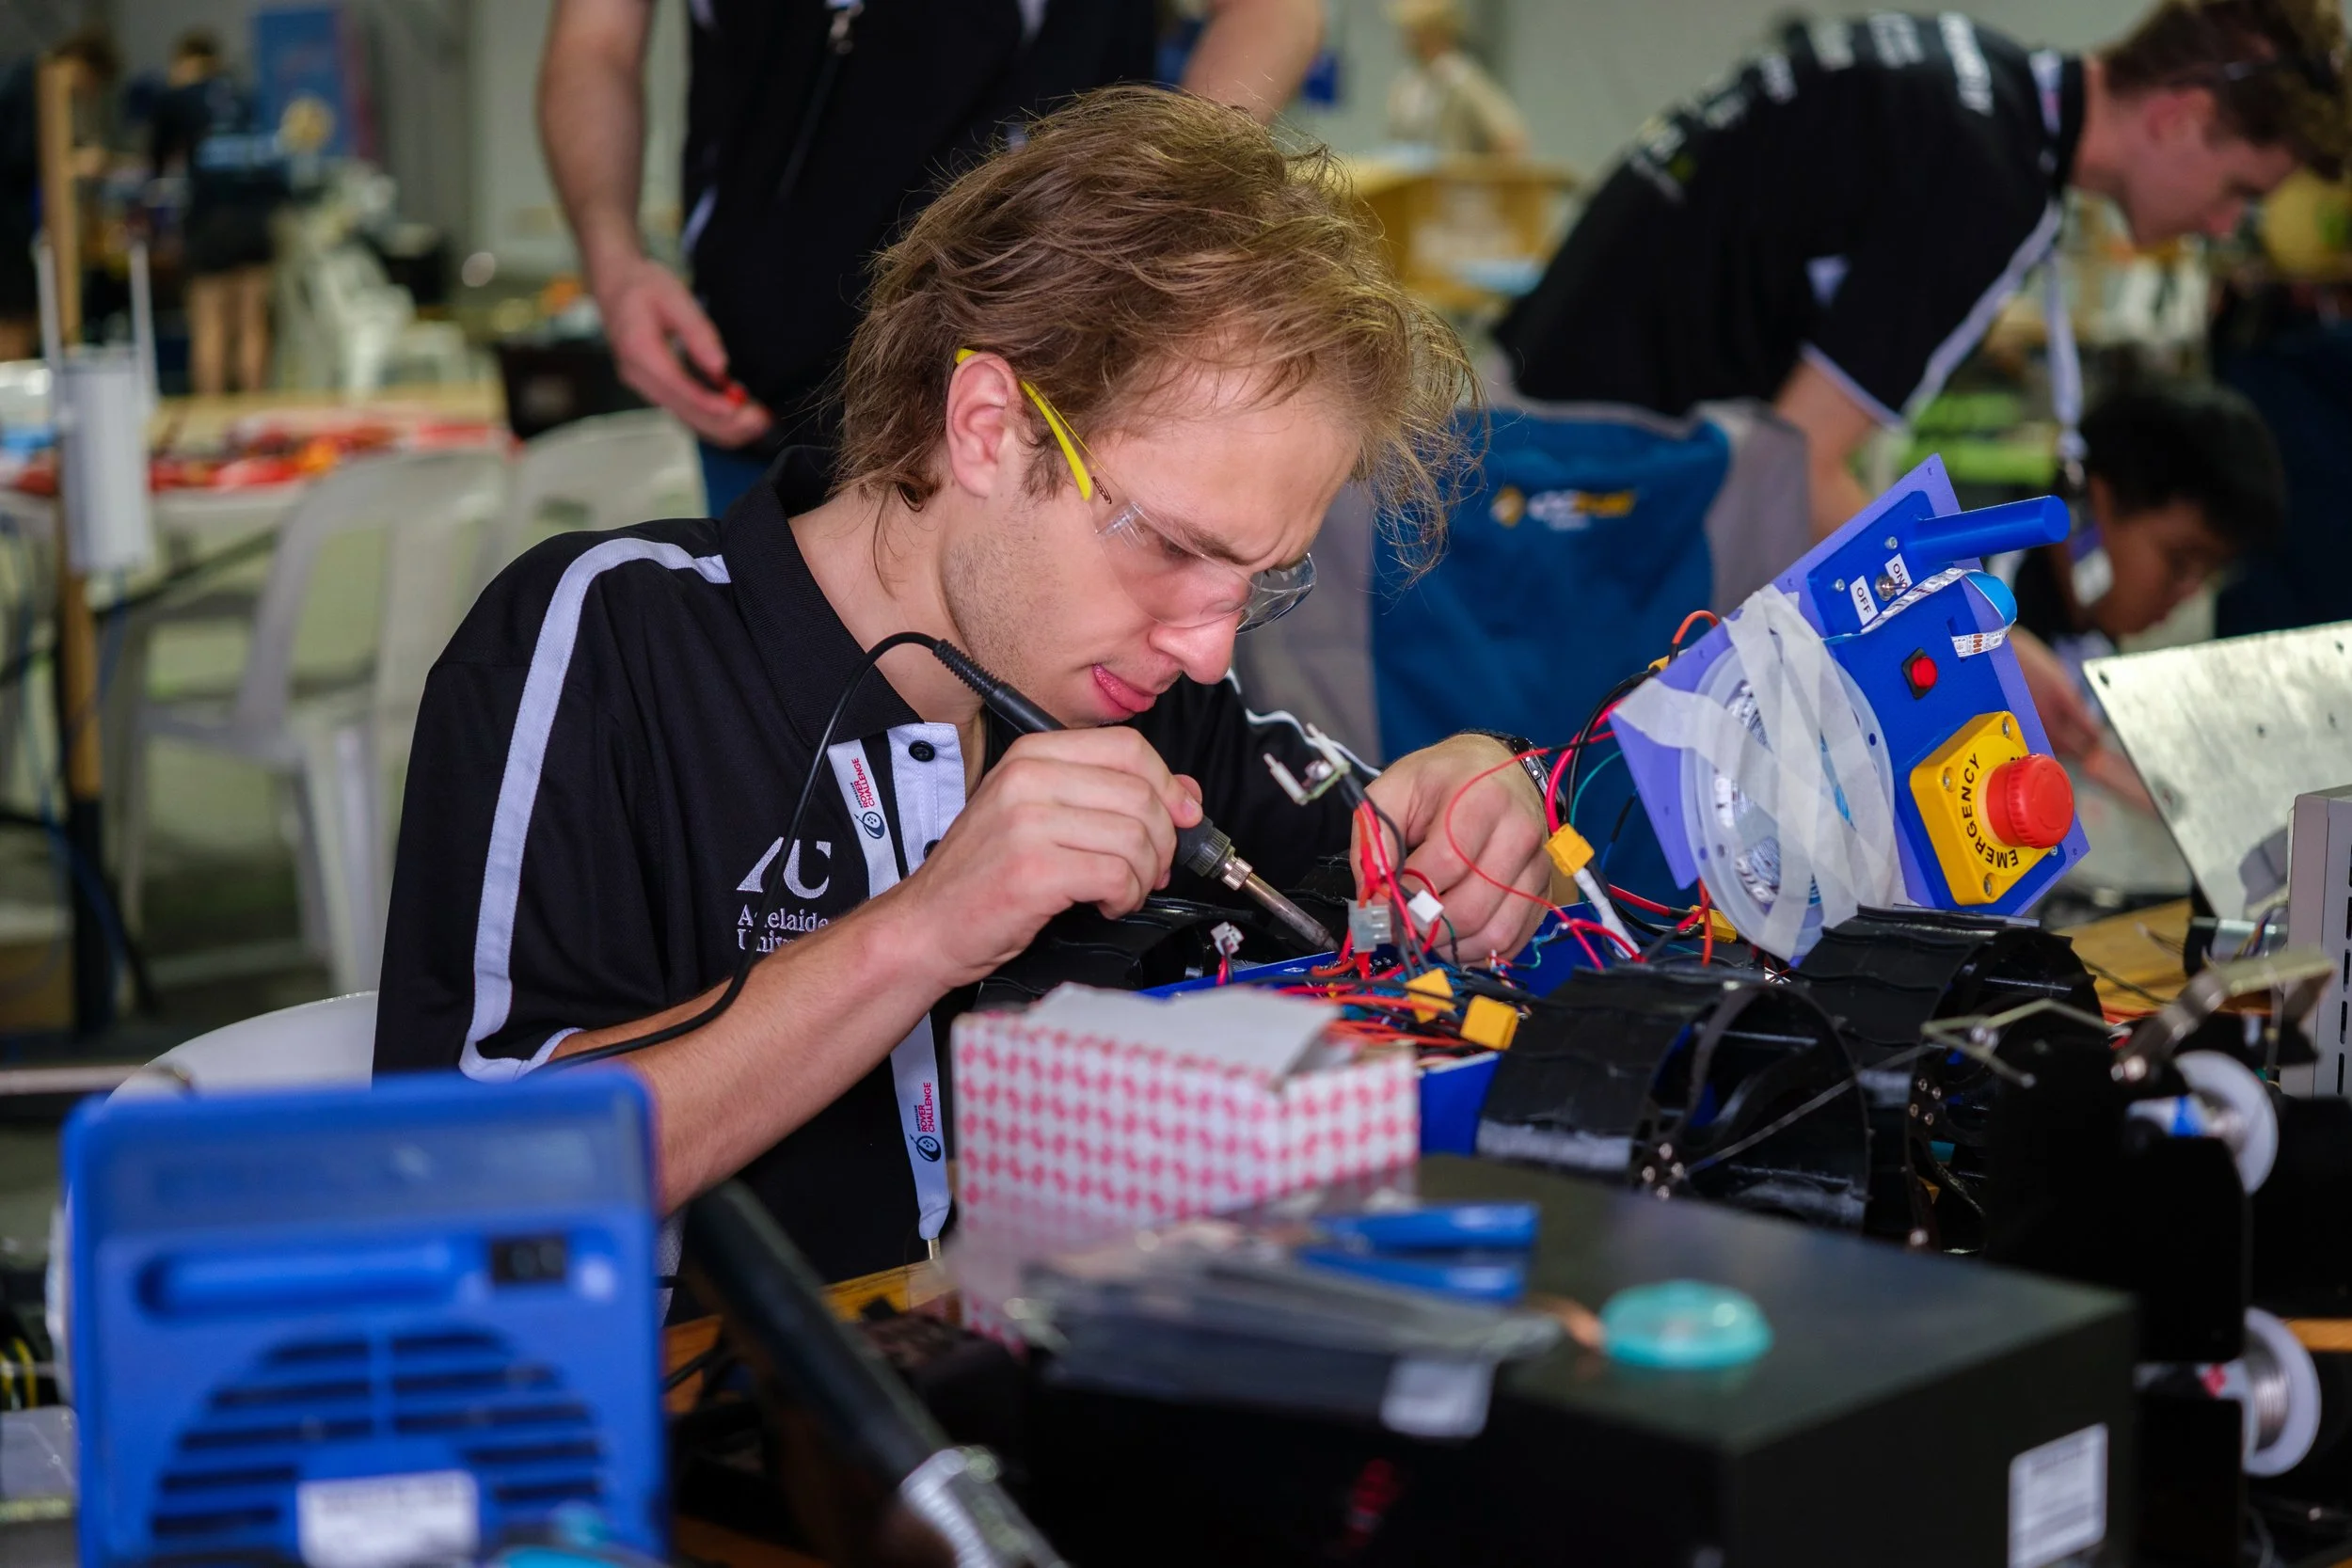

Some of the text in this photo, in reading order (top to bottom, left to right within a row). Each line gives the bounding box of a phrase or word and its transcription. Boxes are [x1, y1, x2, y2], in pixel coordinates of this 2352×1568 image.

[1893, 563, 1906, 585] ON
[1856, 587, 1872, 613] OFF
[851, 757, 876, 807] CHALLENGE
[853, 780, 870, 808] ROVER
[1961, 752, 2020, 869] EMERGENCY
[737, 904, 829, 932] Aelaide
[918, 1104, 930, 1132] ROVER
[923, 1082, 935, 1132] CHALLENGE
